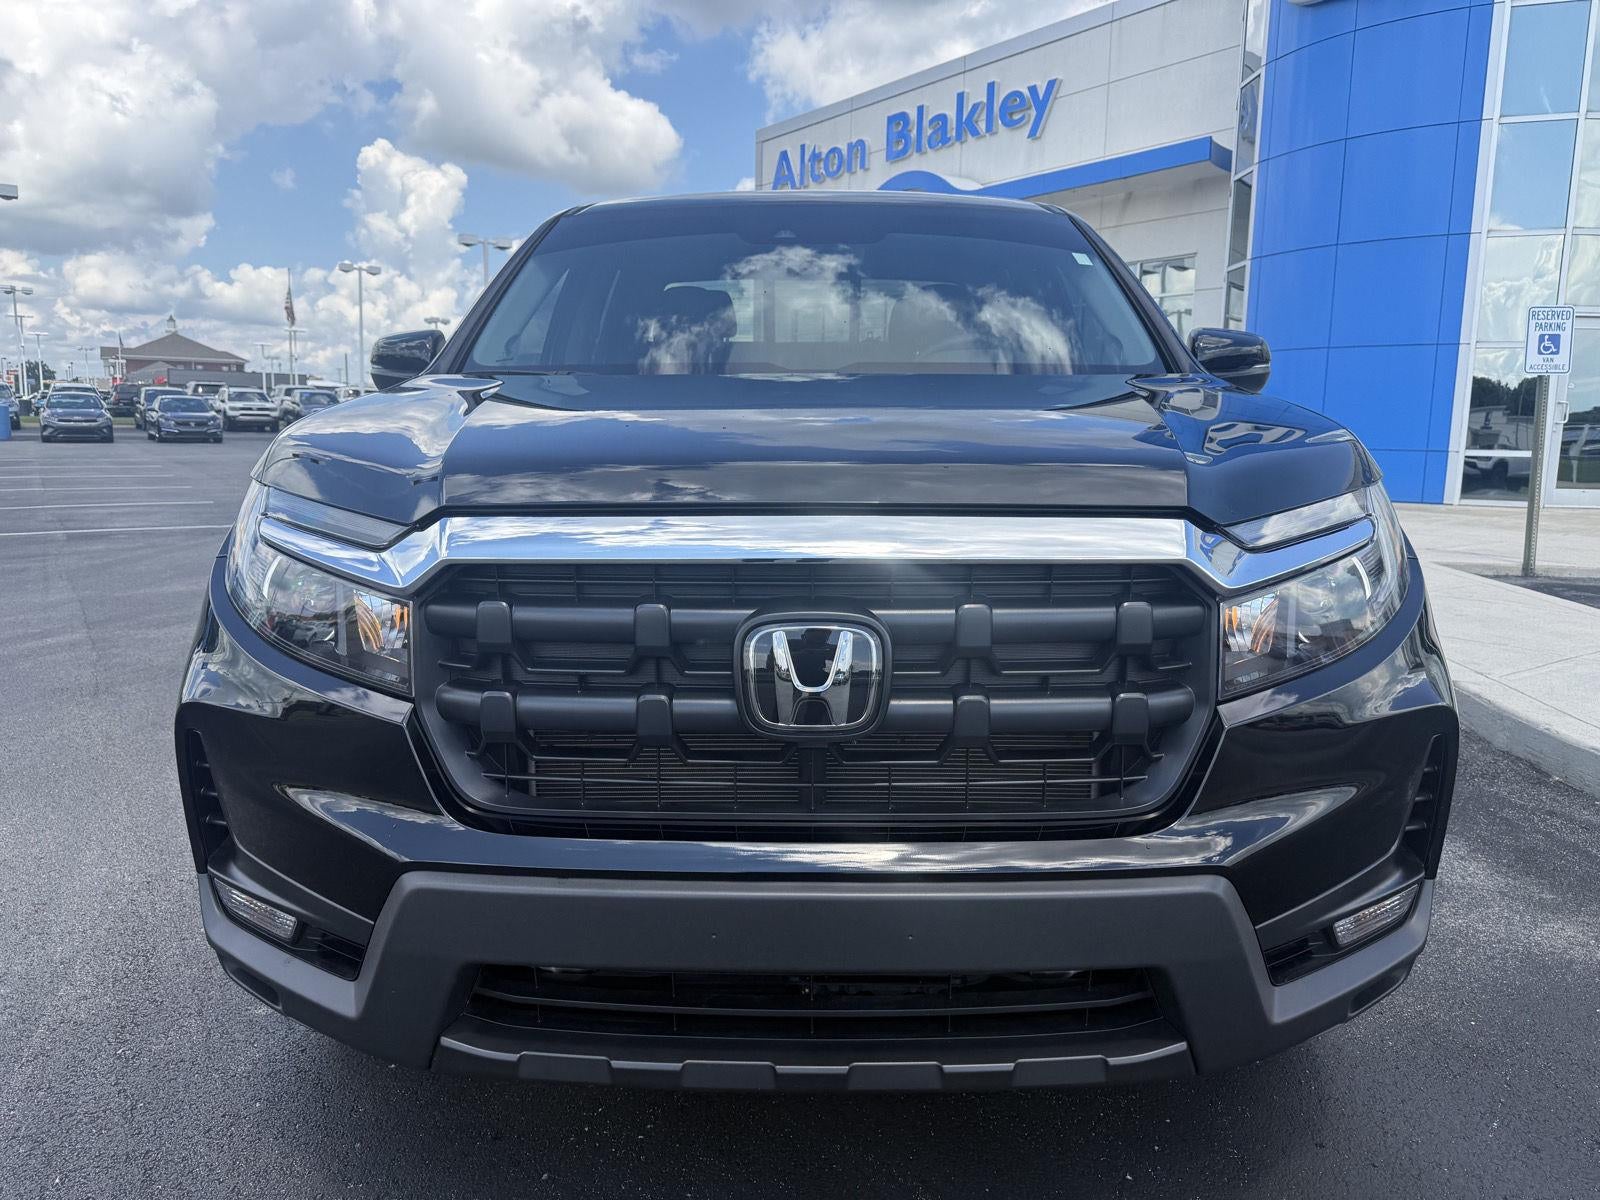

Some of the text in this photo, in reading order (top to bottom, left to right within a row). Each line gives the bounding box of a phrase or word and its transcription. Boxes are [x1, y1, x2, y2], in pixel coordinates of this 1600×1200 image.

[771, 78, 1062, 191] Alton Blakley
[1531, 310, 1571, 321] RESERVED
[1534, 322, 1566, 332] PARKING
